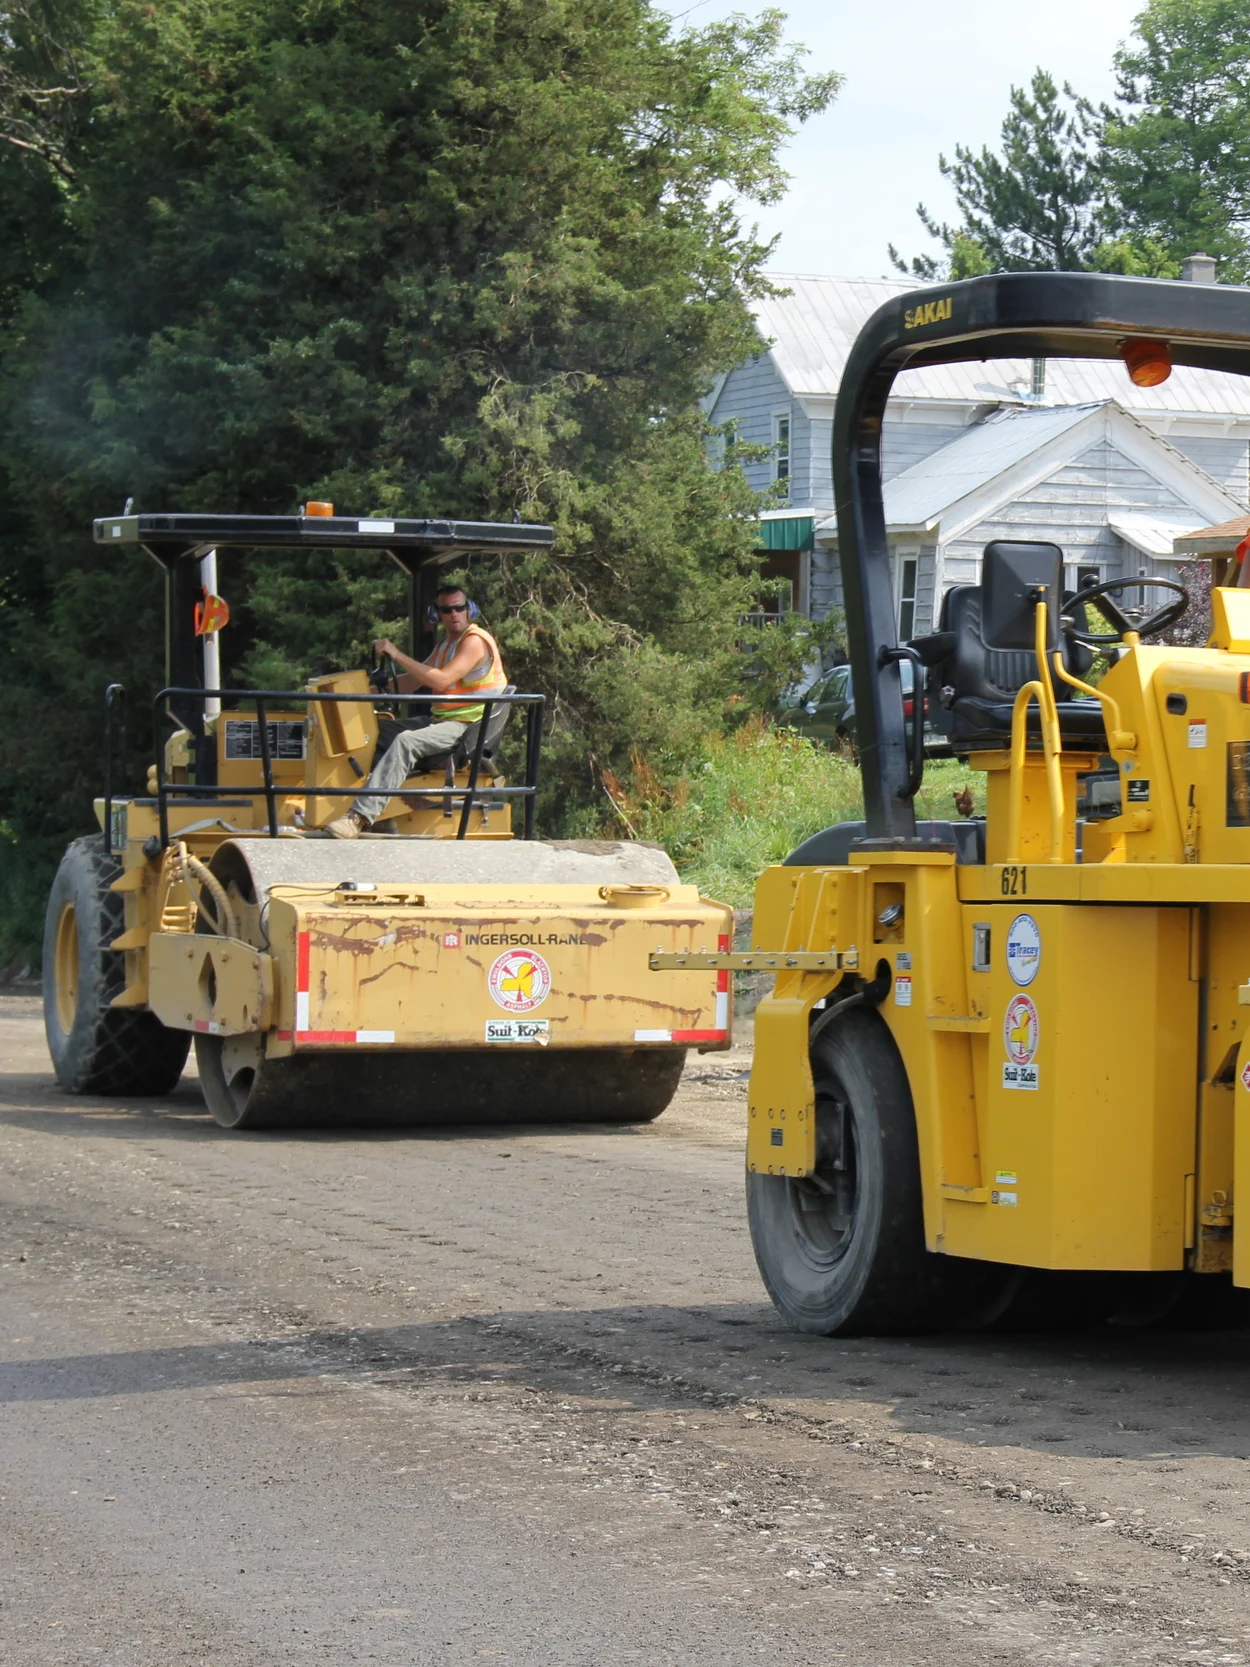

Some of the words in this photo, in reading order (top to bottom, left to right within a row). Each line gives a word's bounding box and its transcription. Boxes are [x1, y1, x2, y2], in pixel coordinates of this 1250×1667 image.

[904, 297, 952, 329] SAKAI
[1001, 866, 1027, 896] 621
[505, 1000, 533, 1010] ASPHALT
